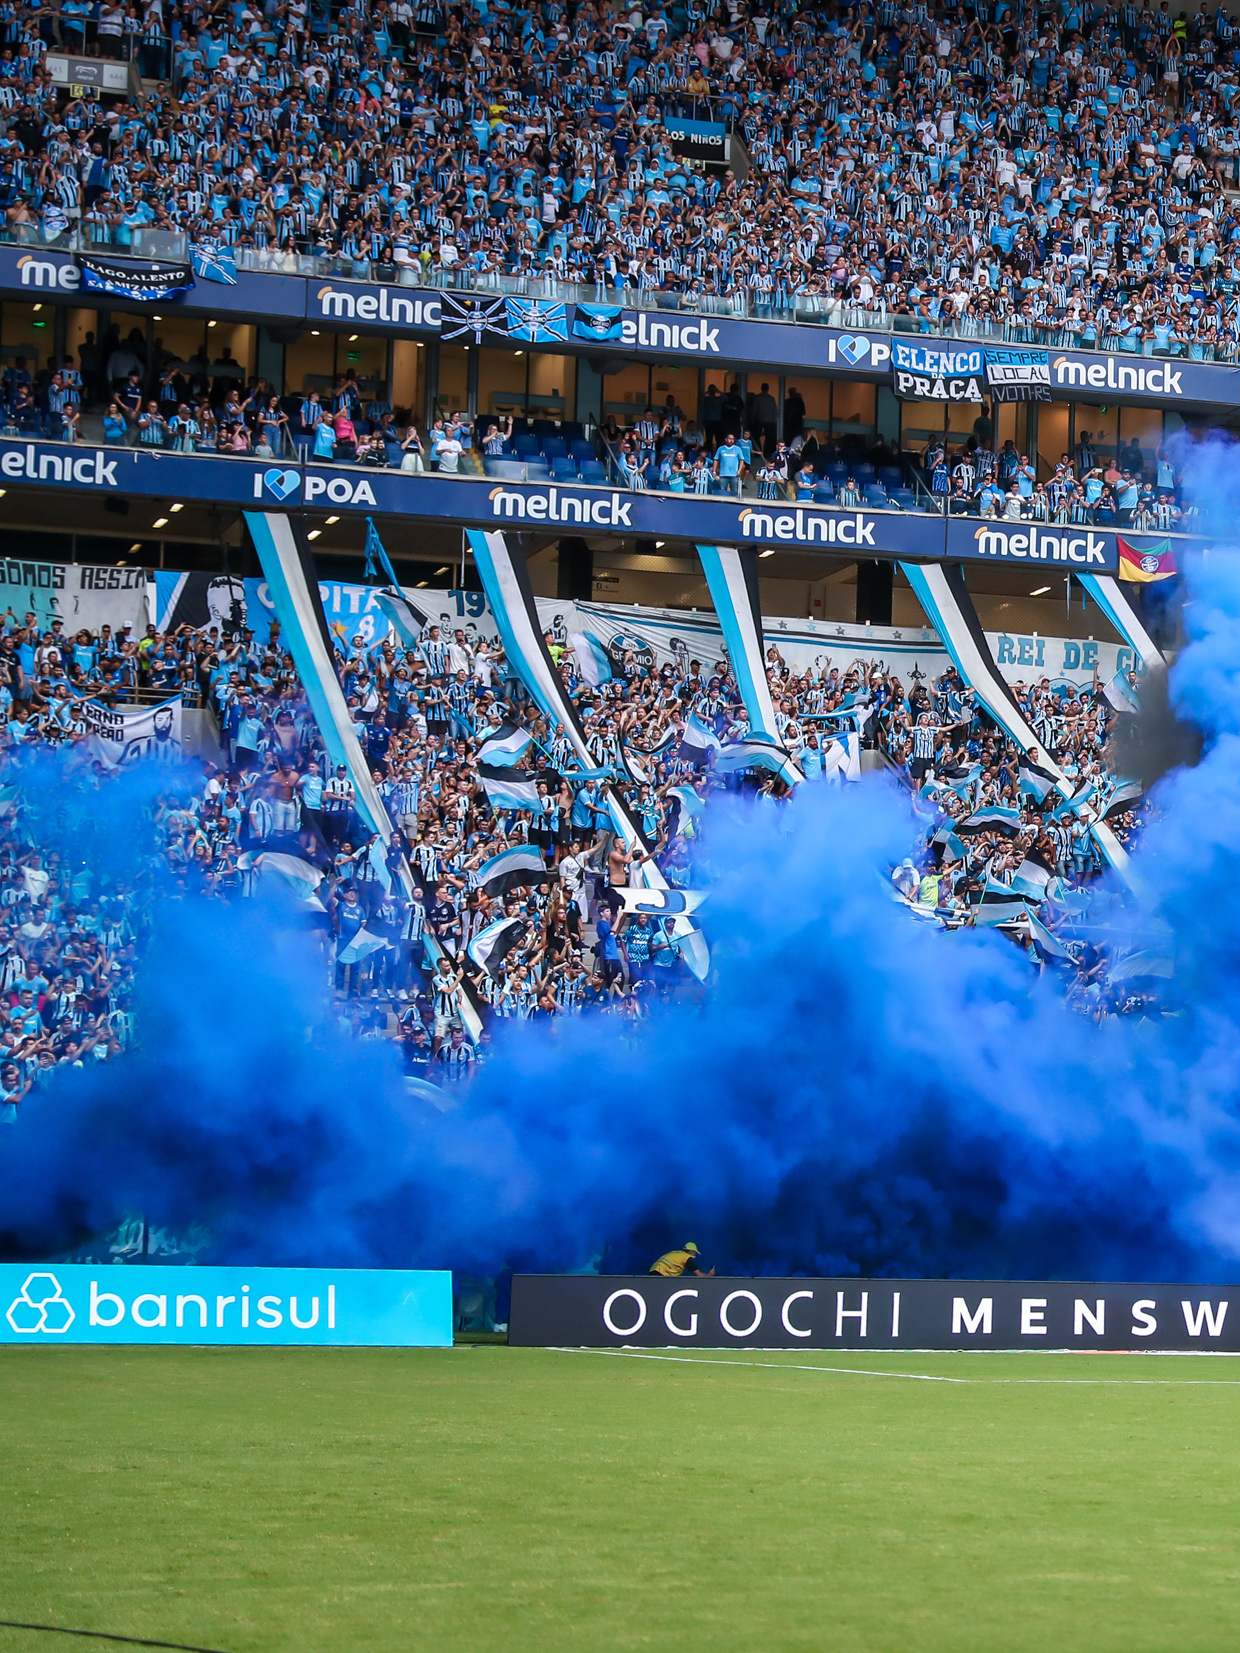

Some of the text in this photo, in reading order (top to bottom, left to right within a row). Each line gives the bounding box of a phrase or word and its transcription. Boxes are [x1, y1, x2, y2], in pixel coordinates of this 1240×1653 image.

[320, 286, 442, 327] melnic
[619, 310, 721, 353] elnick
[896, 343, 981, 373] ELENCO
[931, 372, 946, 380] DA
[985, 350, 1049, 364] SEMPRE
[988, 365, 1049, 381] LOCAL
[1055, 355, 1183, 394] melnick
[897, 371, 982, 400] PRAÇA
[303, 475, 378, 506] POA
[491, 486, 632, 527] melnick
[740, 508, 876, 546] melnick
[976, 526, 1106, 564] melnick
[997, 635, 1046, 667] REI
[1063, 641, 1099, 670] DE
[89, 1280, 336, 1329] banrisul
[602, 1288, 901, 1338] OGOCHI
